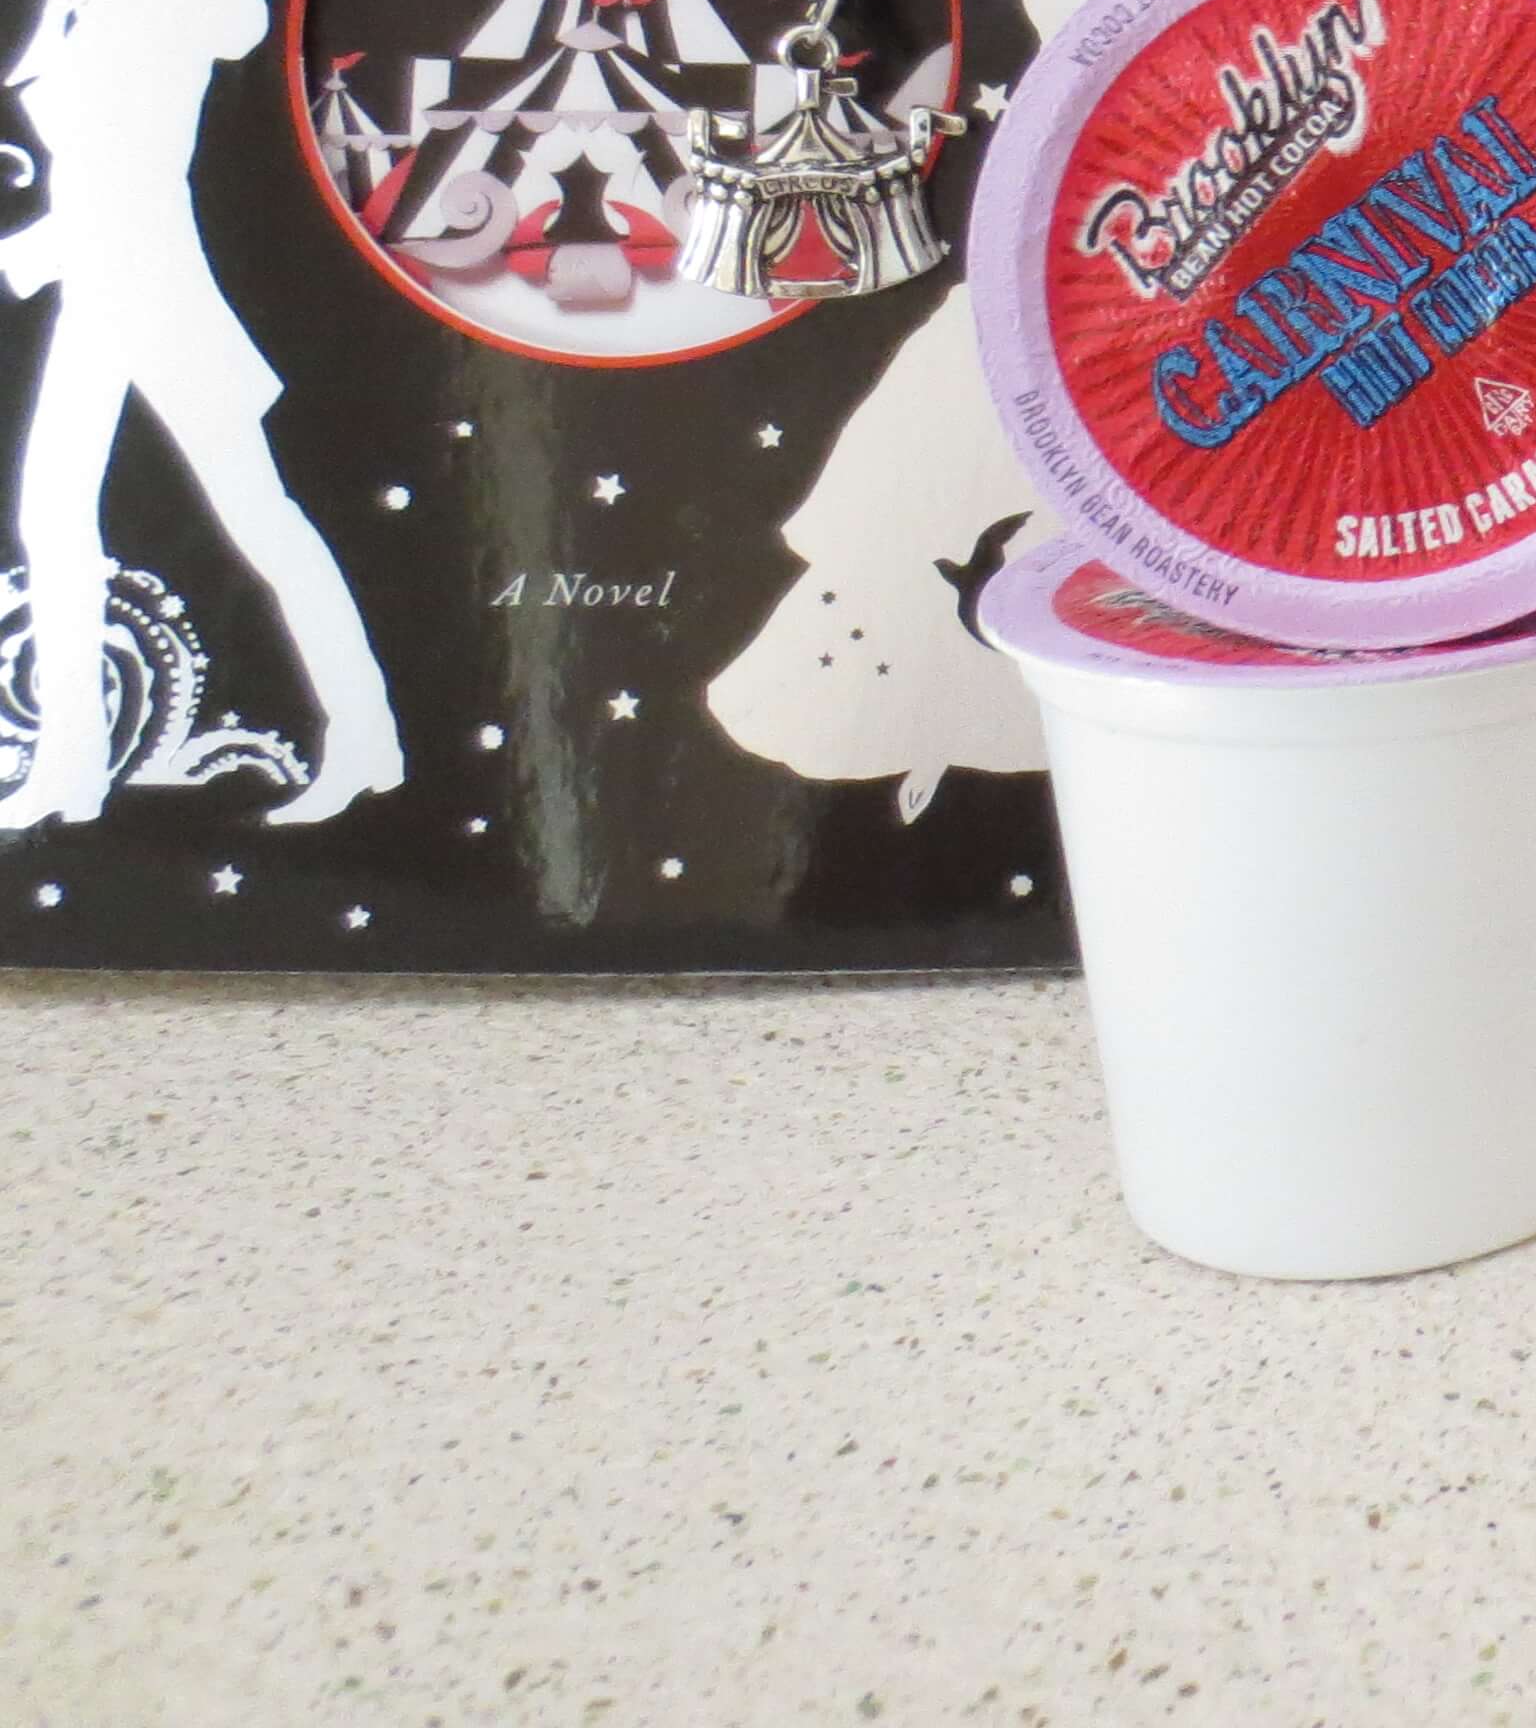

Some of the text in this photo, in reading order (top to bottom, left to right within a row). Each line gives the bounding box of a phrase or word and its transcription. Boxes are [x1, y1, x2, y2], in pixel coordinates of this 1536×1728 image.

[764, 174, 855, 195] CIRCUS
[1168, 98, 1343, 291] BEAN HOT COCOA
[1334, 502, 1466, 559] SALTED
[491, 571, 676, 609] A Novel
